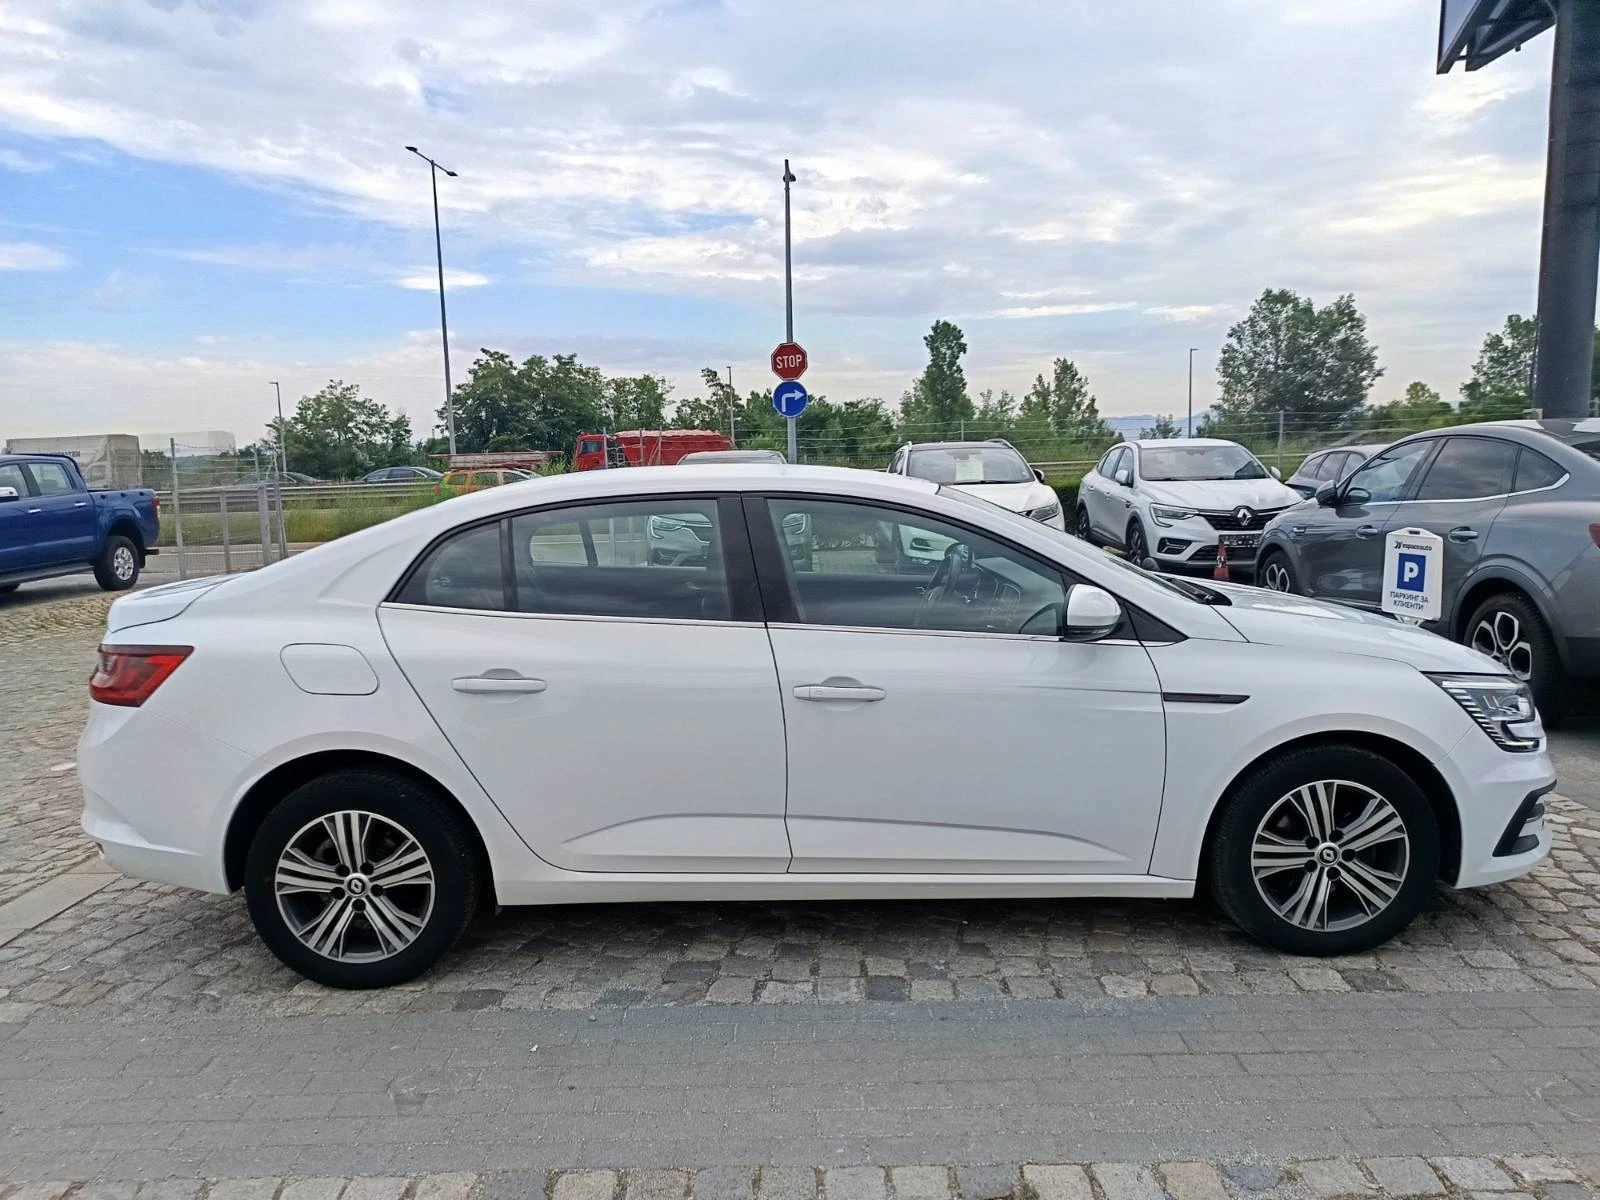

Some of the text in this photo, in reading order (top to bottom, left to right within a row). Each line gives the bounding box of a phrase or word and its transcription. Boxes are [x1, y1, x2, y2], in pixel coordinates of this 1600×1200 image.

[776, 354, 802, 369] STOP
[1403, 561, 1419, 583] P
[1390, 591, 1429, 603] ПАРКИНГ ЗА
[1393, 600, 1424, 610] КЛИЕНТИ
